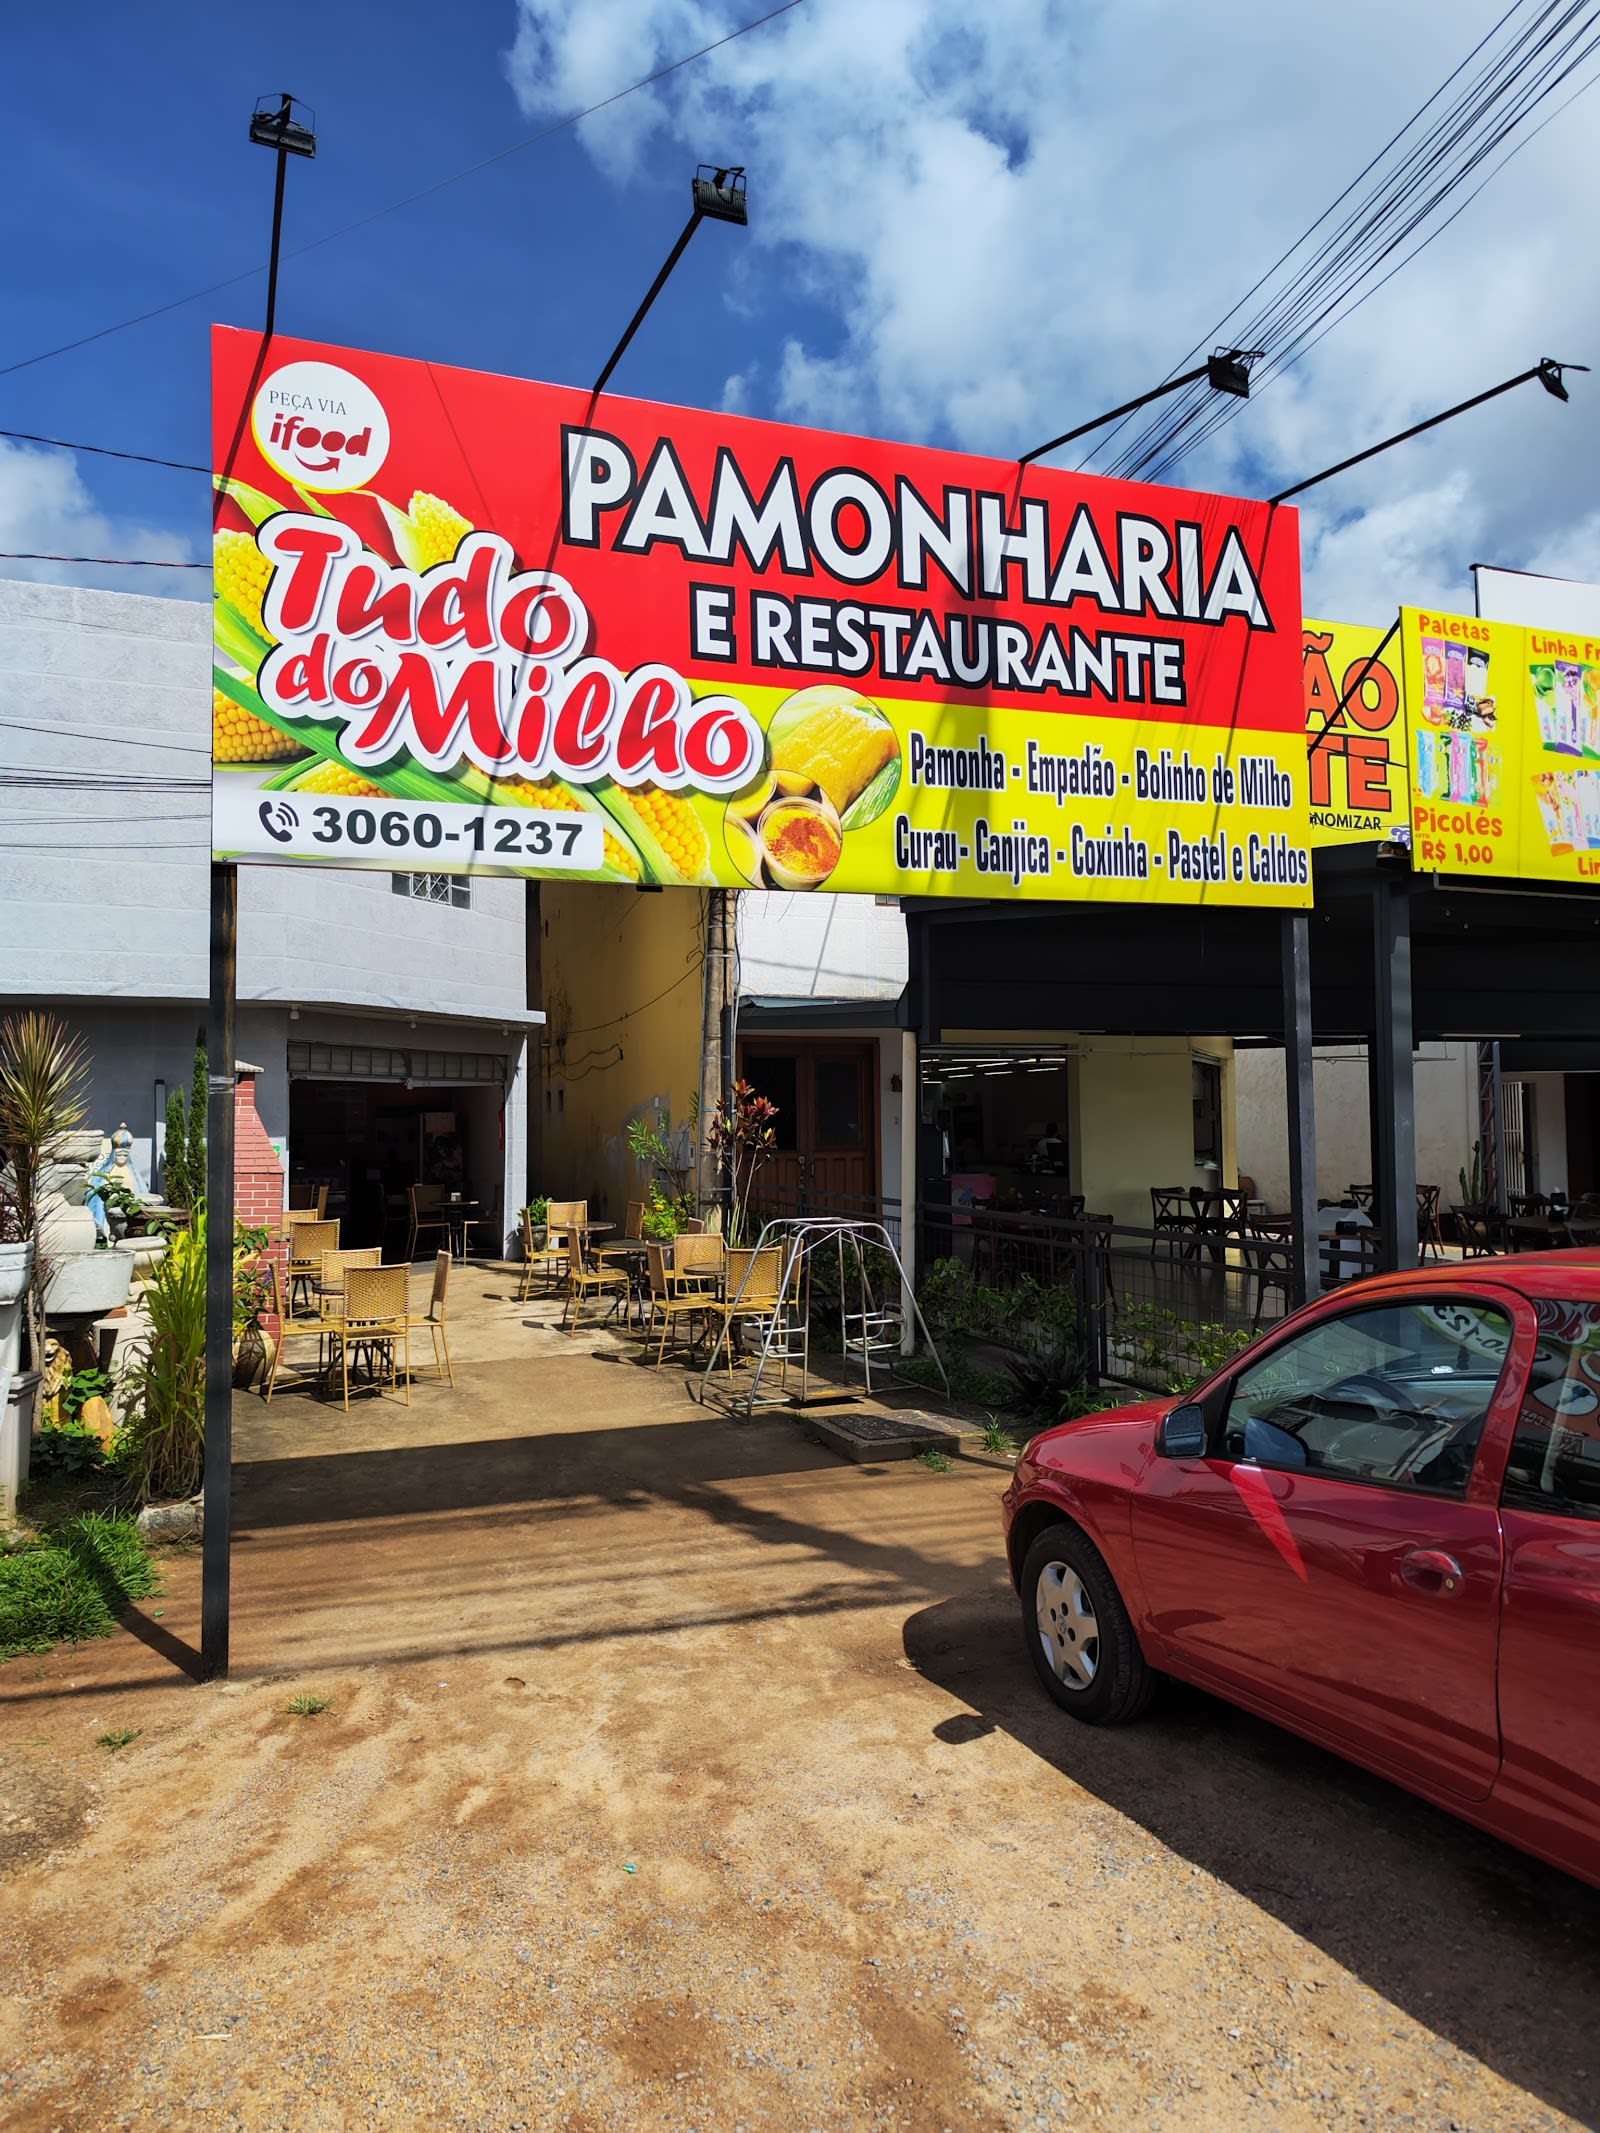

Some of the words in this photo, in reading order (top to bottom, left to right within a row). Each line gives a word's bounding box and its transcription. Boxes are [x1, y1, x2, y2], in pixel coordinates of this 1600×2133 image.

[269, 390, 313, 411] PEÇA
[318, 398, 347, 415] VIA
[270, 412, 372, 457] ifood
[561, 424, 1275, 633] PAMONHARIA
[273, 526, 572, 656] Tudo
[690, 582, 737, 663] E
[751, 590, 1187, 707] RESTAURANTE
[1418, 614, 1490, 642] Paletas
[1532, 635, 1578, 659] Linha
[275, 632, 383, 705] do
[354, 651, 750, 777] Milho
[911, 732, 1005, 790] Pamonha
[1027, 741, 1115, 806] Empadão
[1136, 750, 1206, 802] Bolinho
[1212, 755, 1234, 804] de
[1240, 757, 1291, 807] Milho
[312, 806, 584, 857] 3060-1237
[1414, 806, 1503, 838] Picolés
[975, 819, 1050, 885] Canjica
[1072, 825, 1148, 878] Coxinha
[1168, 830, 1226, 880] Pastel
[1232, 846, 1243, 881] e
[1249, 834, 1308, 884] Caldos
[1421, 839, 1447, 865] R$
[1454, 843, 1494, 866] 1,00
